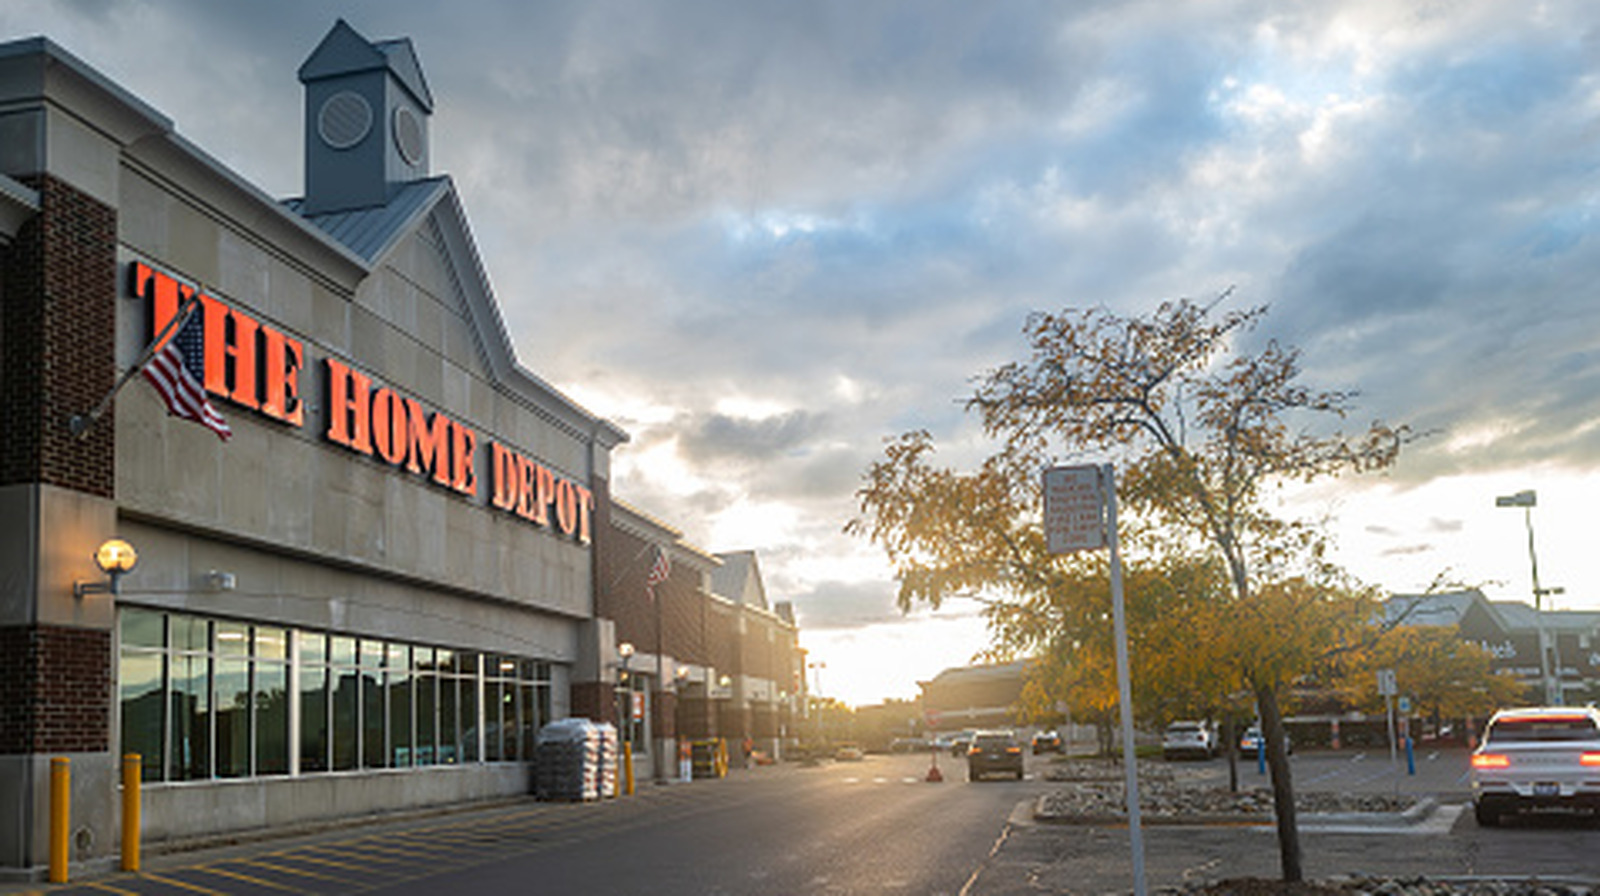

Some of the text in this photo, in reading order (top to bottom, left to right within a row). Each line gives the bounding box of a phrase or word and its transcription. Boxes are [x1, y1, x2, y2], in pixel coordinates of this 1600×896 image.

[134, 261, 594, 545] THE HOME DEPOT
